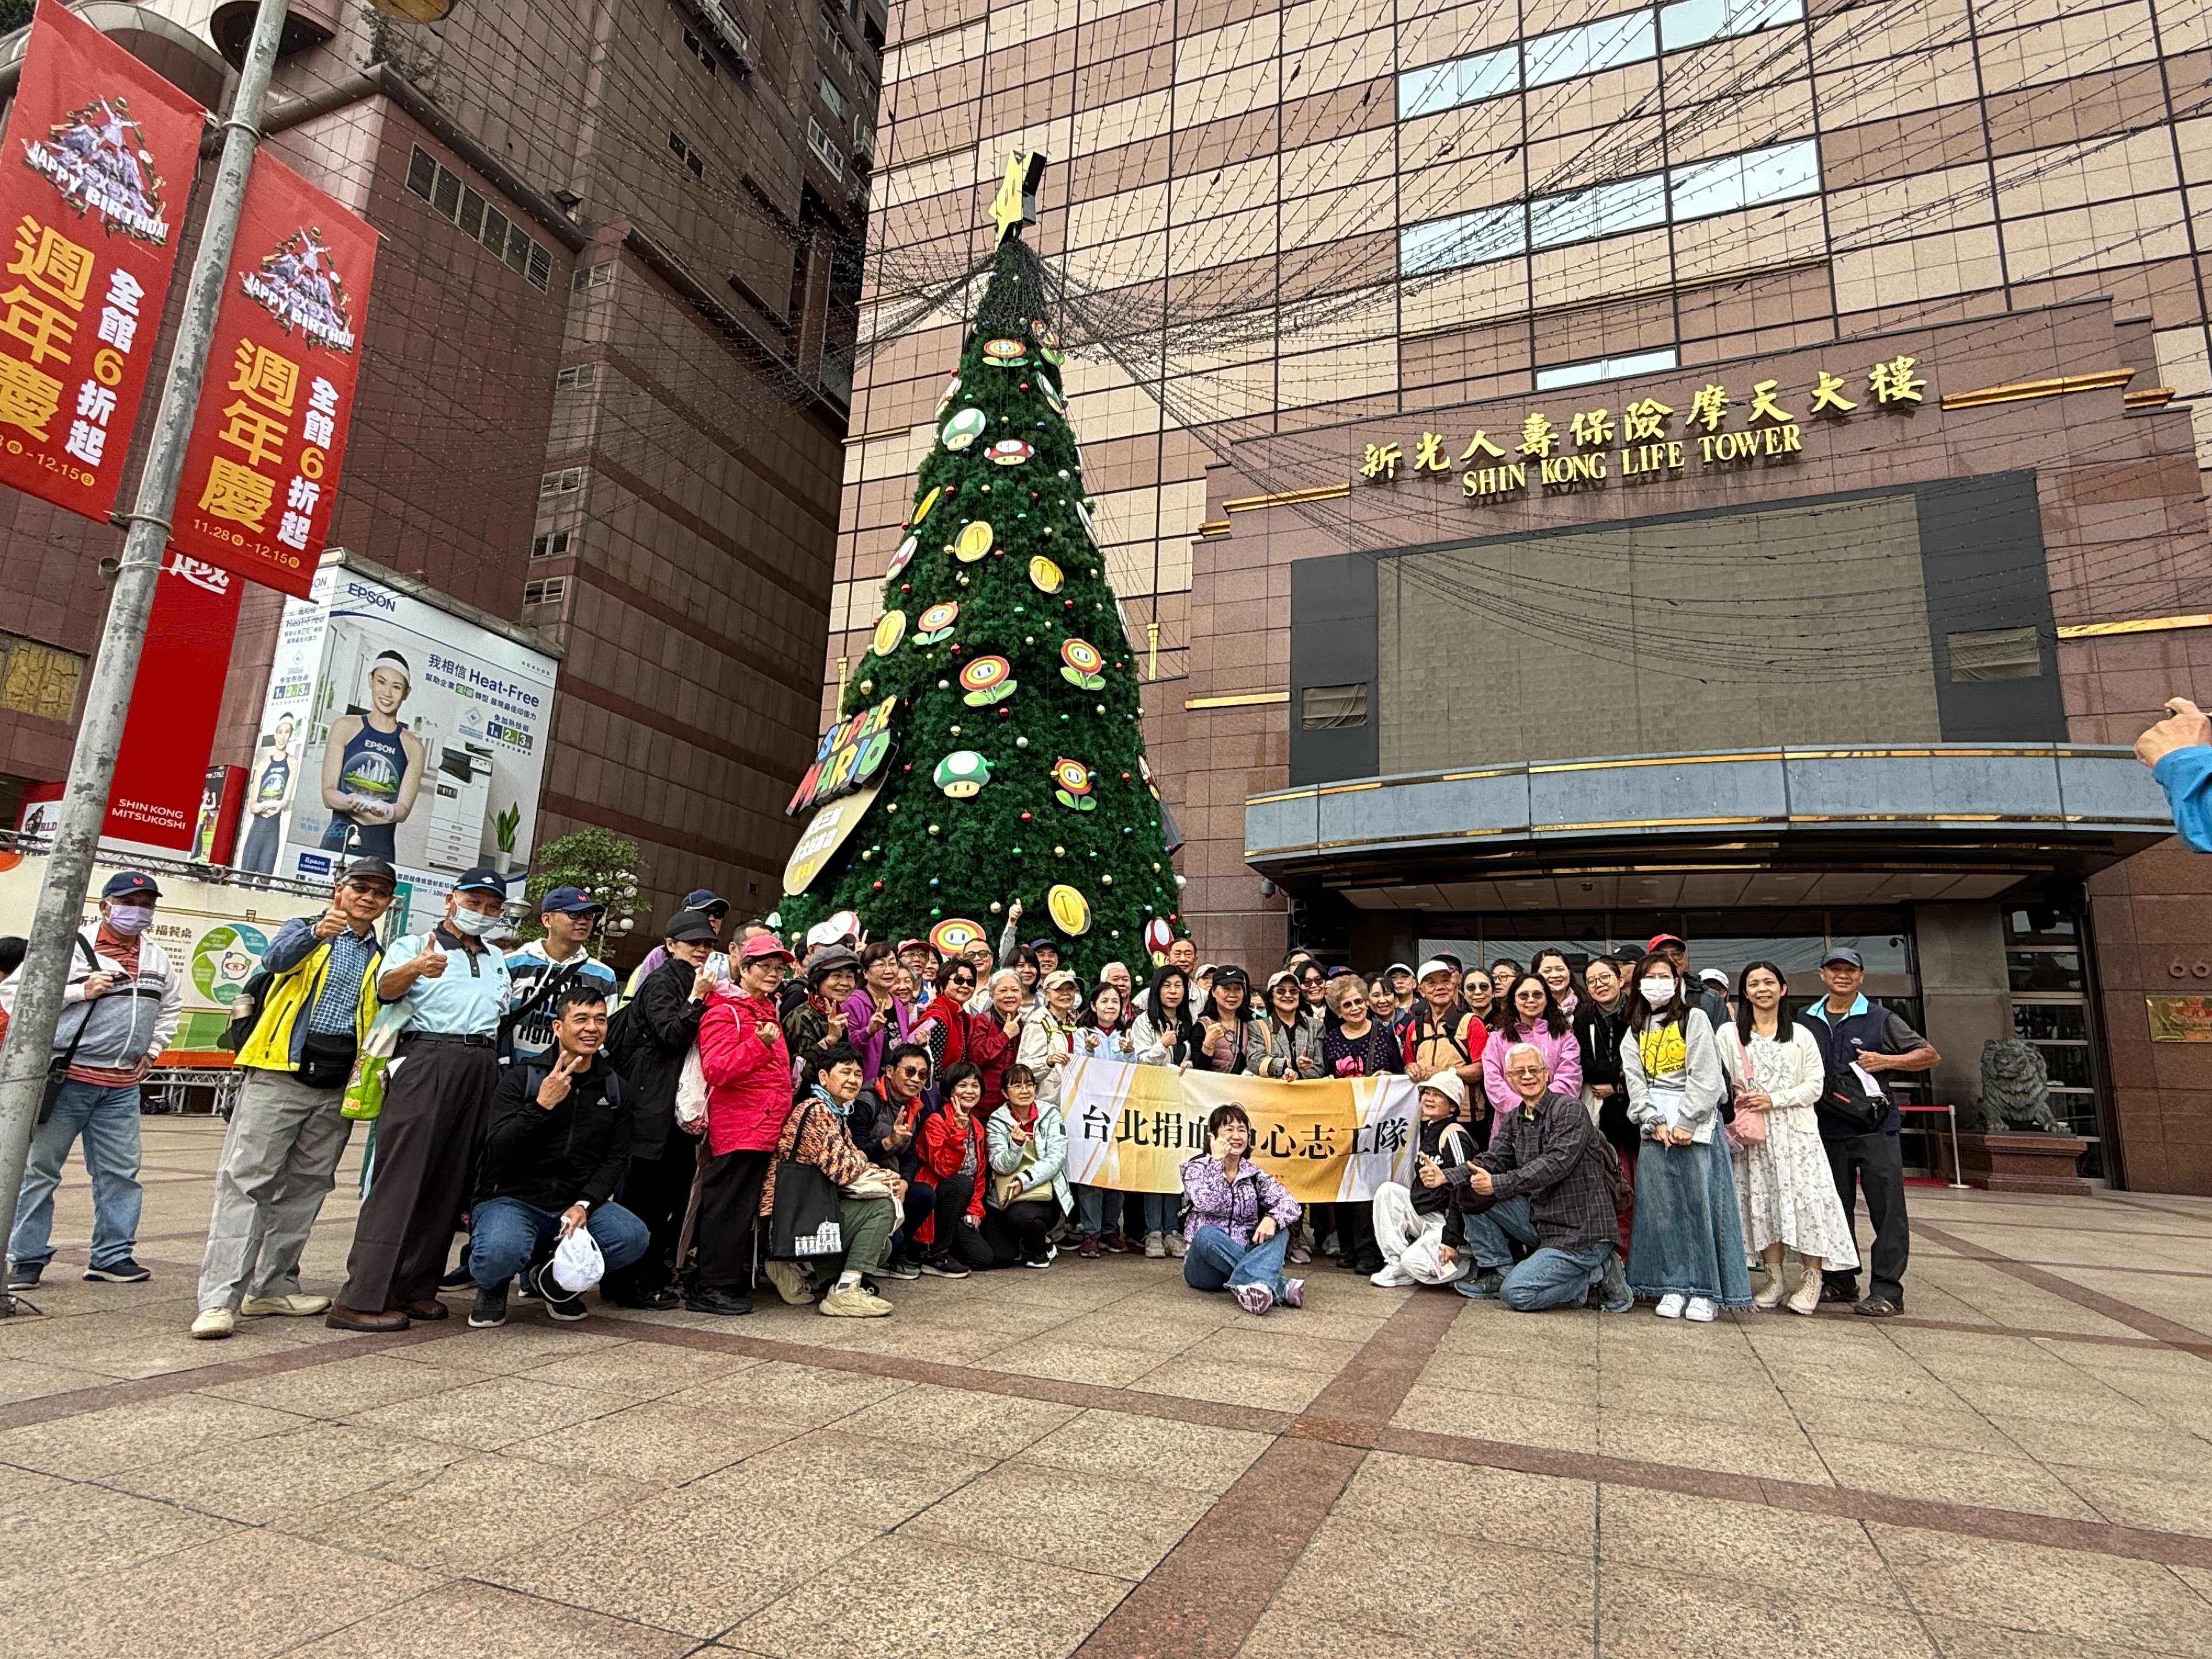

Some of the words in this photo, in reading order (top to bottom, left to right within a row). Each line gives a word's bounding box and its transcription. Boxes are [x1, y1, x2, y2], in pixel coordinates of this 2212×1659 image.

[27, 140, 83, 193] HAPPY
[86, 186, 170, 238] BIRTHDAY
[0, 215, 97, 442] 週年慶
[244, 272, 289, 314] HAPPY
[291, 307, 356, 347] BIRTHDAY
[64, 268, 145, 467] 全館6折起
[198, 338, 300, 533] 週年慶
[1358, 356, 1928, 479] 新光人壽保險摩天大樓
[277, 376, 340, 551] 全館6折起
[1463, 462, 1526, 496] SHIN
[1540, 452, 1607, 485] KONG
[1621, 441, 1685, 475] LIFE
[1697, 424, 1802, 462] TOWER
[348, 583, 396, 612] EPSON
[428, 653, 467, 680] 我相信
[469, 668, 539, 708] Heat-Free
[364, 740, 396, 755] EPSON
[818, 695, 898, 760] SUPER
[789, 730, 891, 809] MARIO
[112, 808, 187, 831] MITSUKOSHI
[119, 799, 148, 811] SHIN
[150, 805, 184, 820] KONG
[1082, 1104, 1407, 1160] 台北捐血心志工隊
